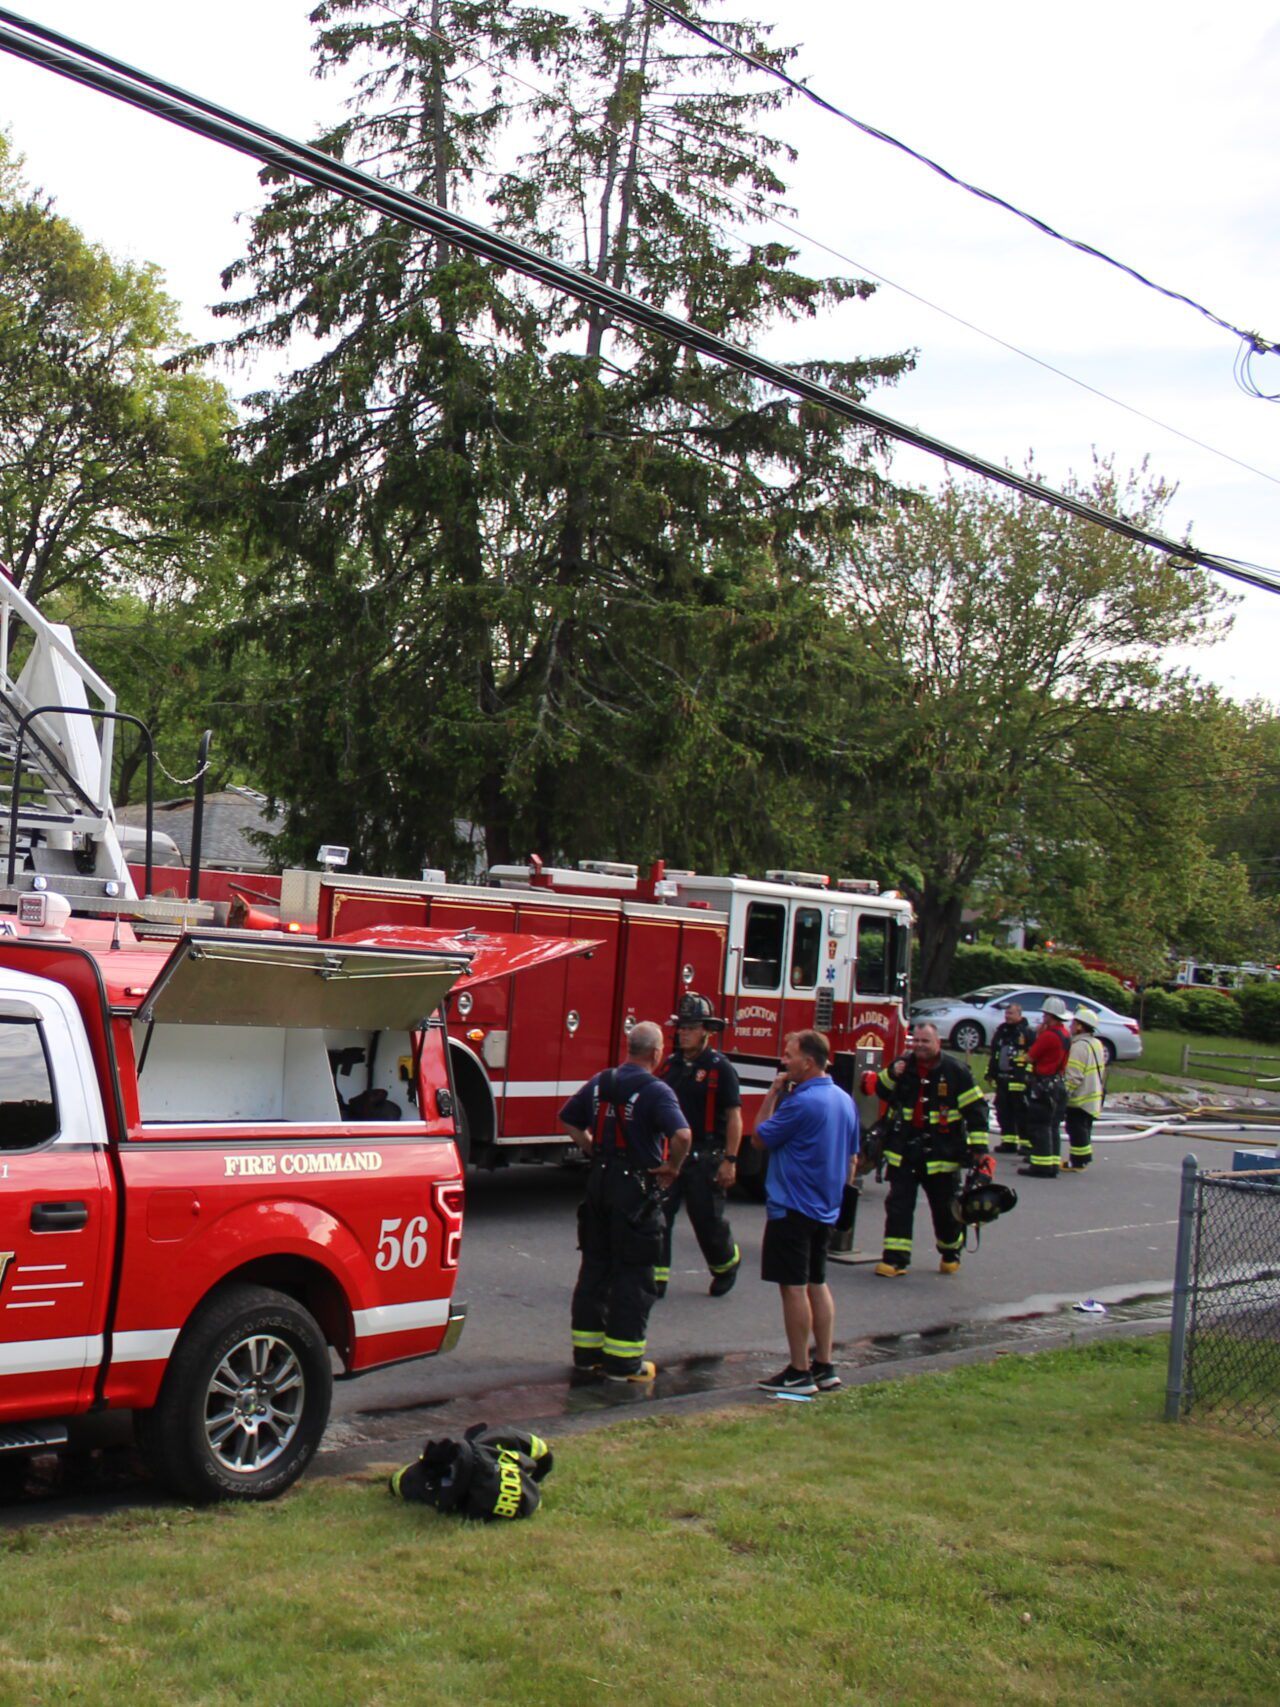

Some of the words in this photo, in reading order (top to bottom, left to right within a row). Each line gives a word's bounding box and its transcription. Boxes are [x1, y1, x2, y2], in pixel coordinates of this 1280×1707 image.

[852, 1011, 890, 1031] LADDER
[734, 1026, 751, 1037] FIRE
[1, 1164, 10, 1179] 1
[224, 1155, 277, 1177] FIRE
[279, 1151, 383, 1175] COMMAND
[375, 1216, 429, 1271] 56
